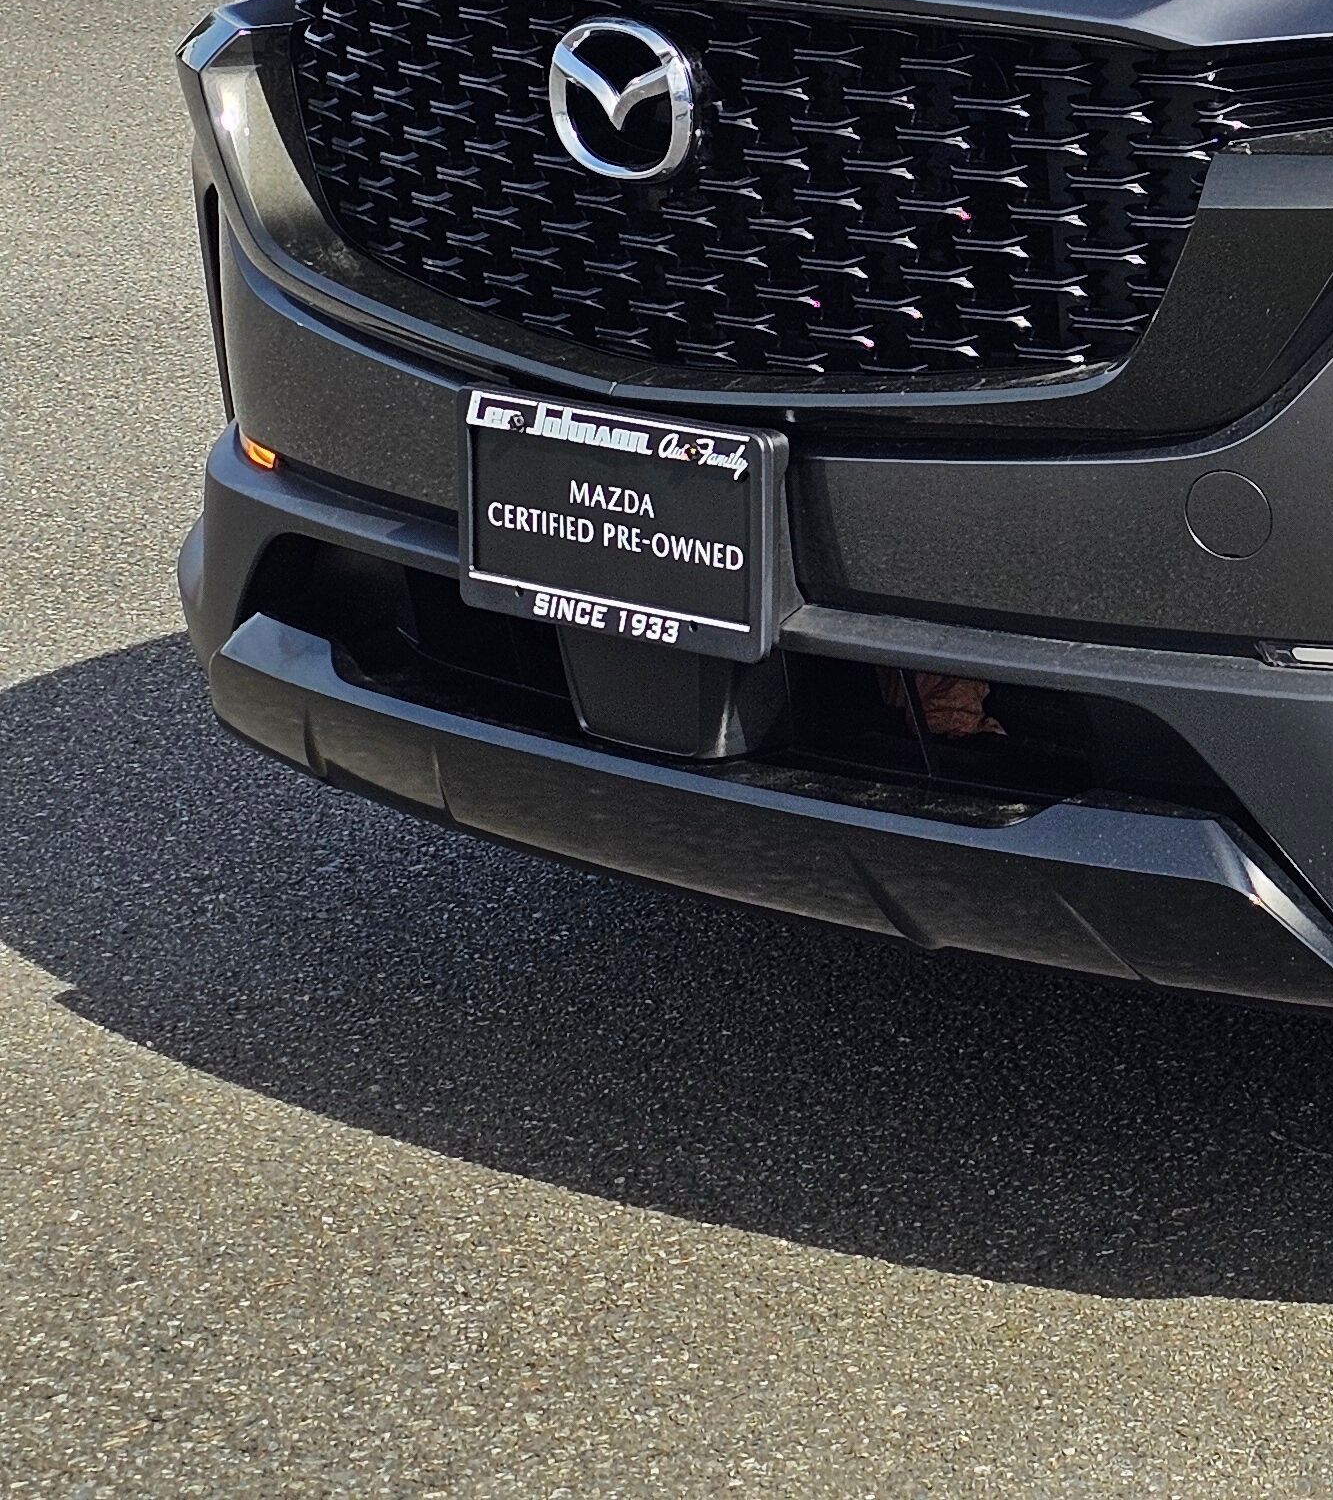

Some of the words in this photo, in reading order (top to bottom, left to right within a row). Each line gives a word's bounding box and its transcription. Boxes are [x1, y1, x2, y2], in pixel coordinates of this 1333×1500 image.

[526, 401, 653, 455] Johnson
[658, 433, 699, 461] Aut
[696, 438, 748, 480] Family
[569, 479, 655, 519] MAZDA
[487, 501, 595, 543] CERTIFIED
[603, 522, 744, 571] PRE-OWNED
[533, 592, 608, 629] SINCE
[618, 610, 680, 644] 1933
